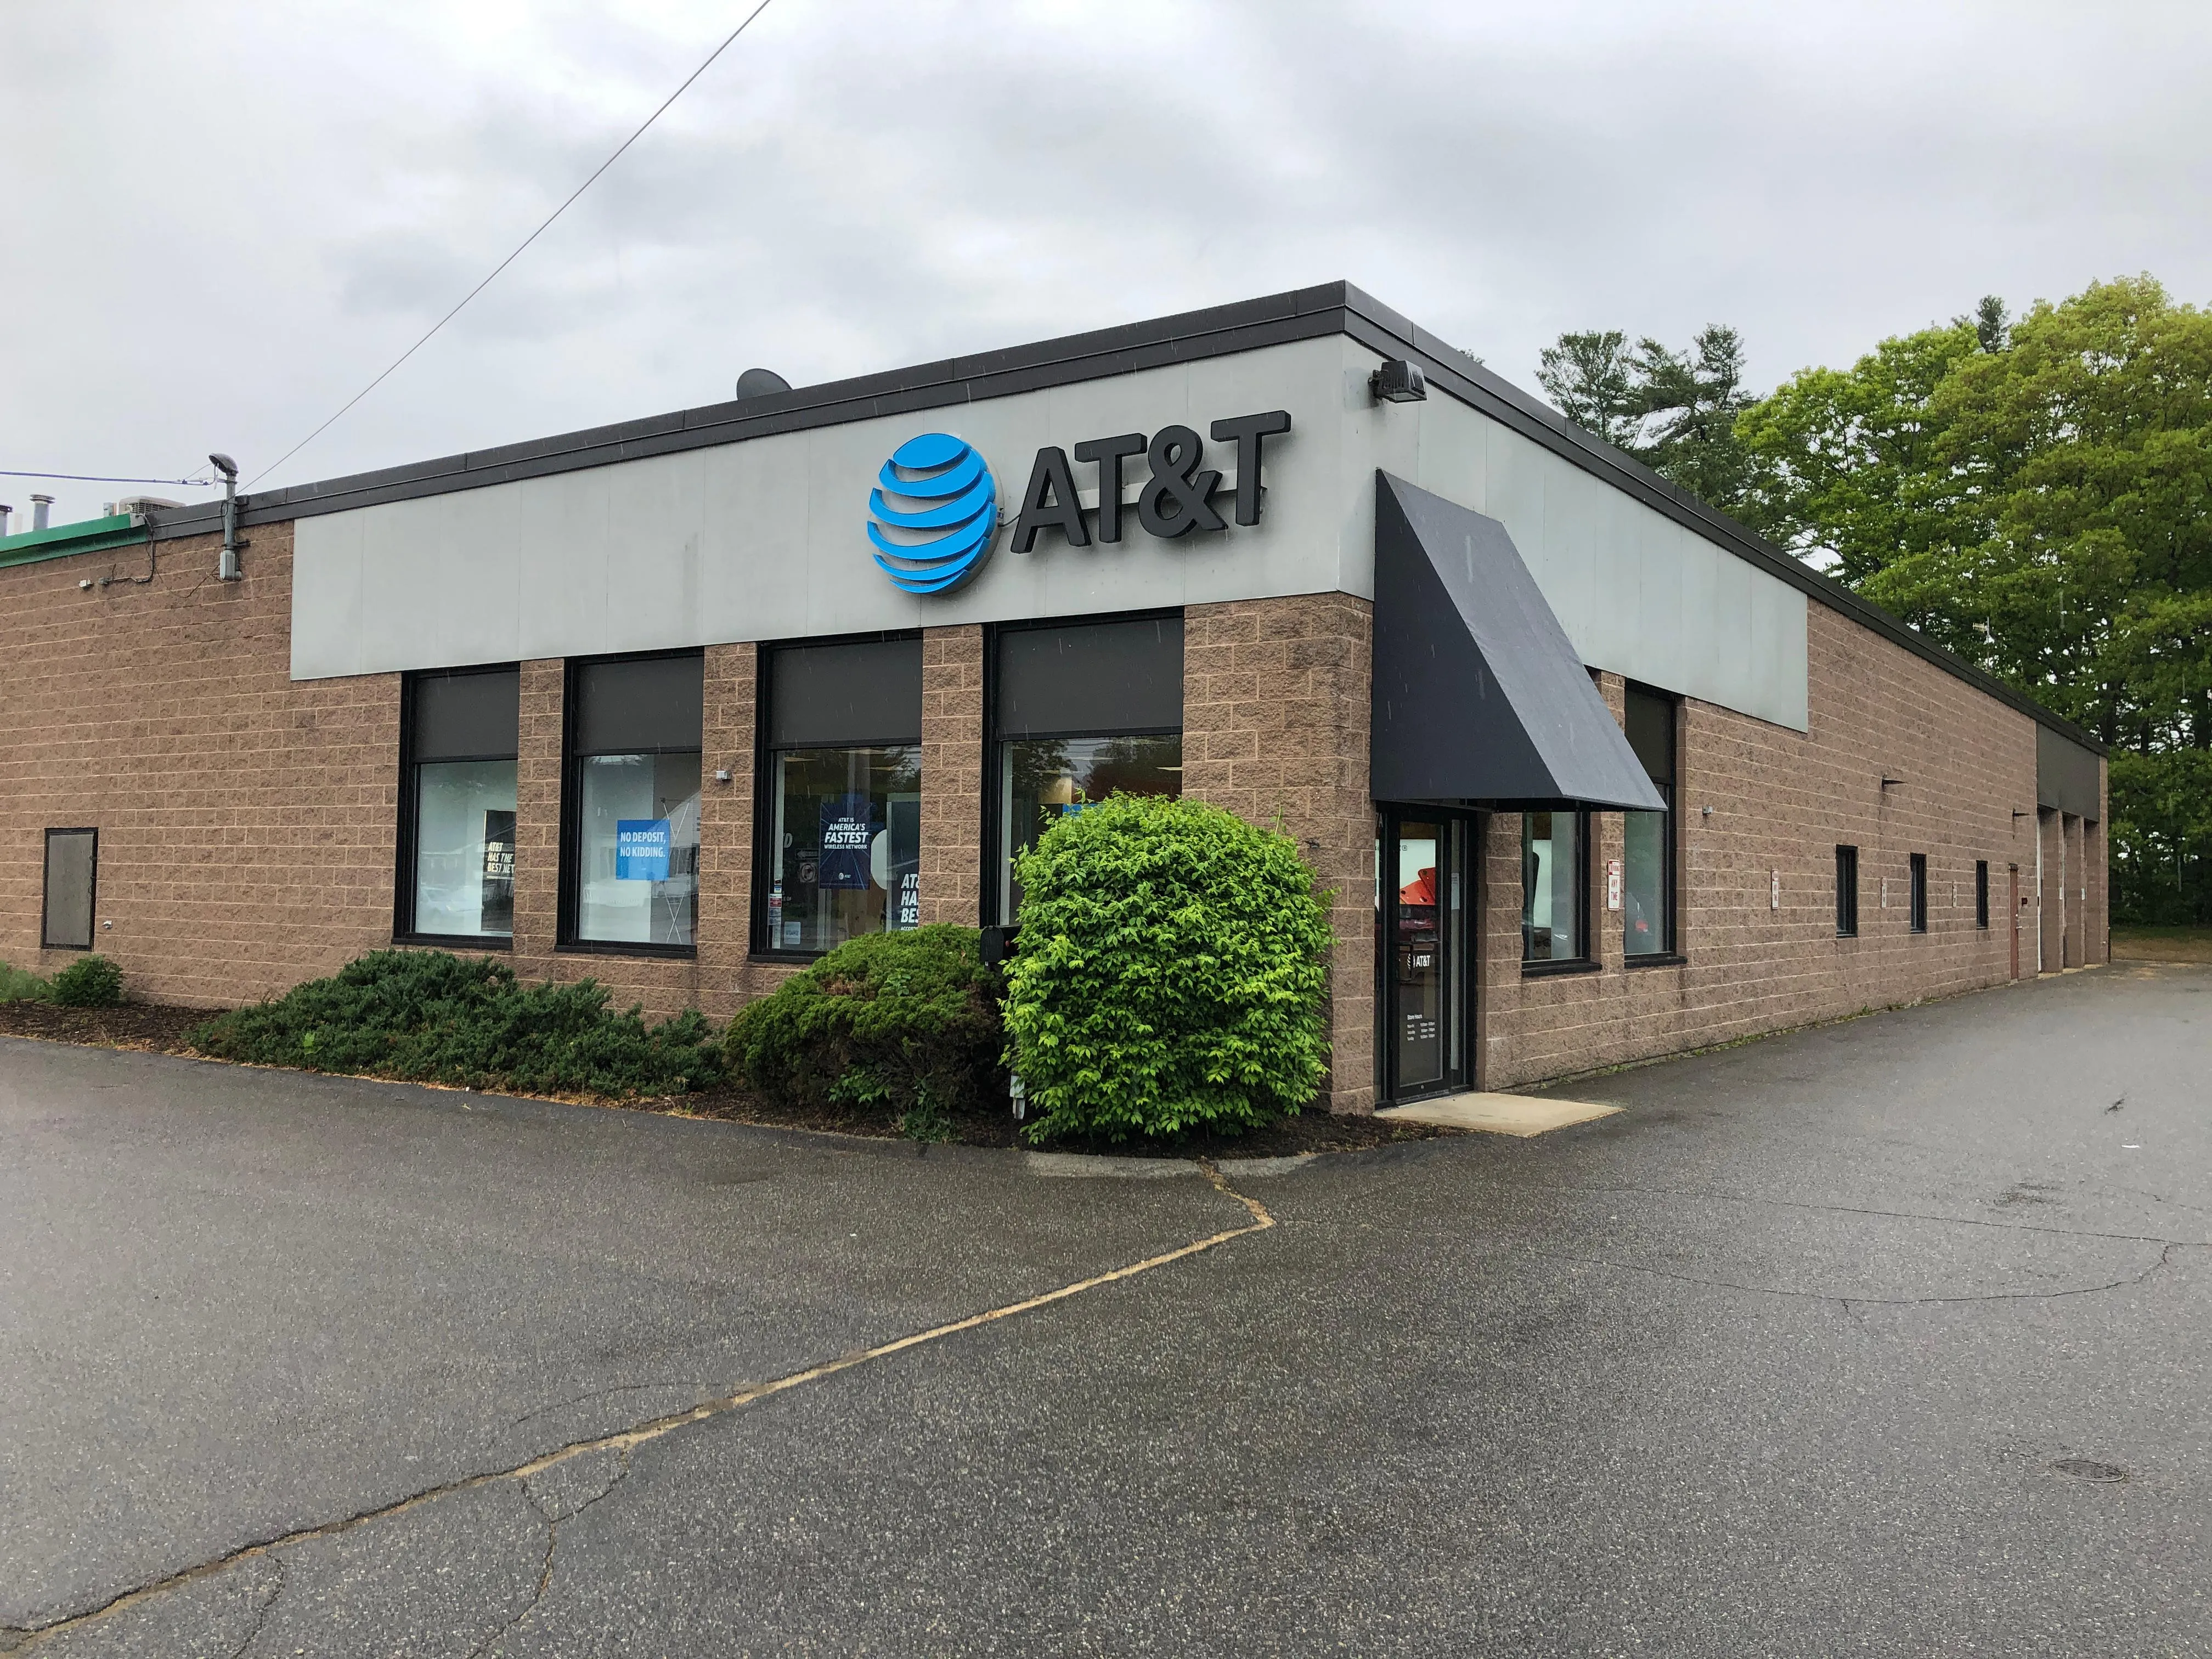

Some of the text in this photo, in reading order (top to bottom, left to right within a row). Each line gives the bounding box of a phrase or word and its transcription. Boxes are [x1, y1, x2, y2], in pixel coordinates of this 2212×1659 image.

[1011, 410, 1291, 554] AT&T
[620, 832, 666, 844] NO DEPOSIT,
[825, 832, 868, 843] FASTEST
[488, 842, 503, 851] AT&T
[620, 847, 665, 857] NO KIDDING.
[487, 852, 514, 863] HAS THE
[487, 862, 503, 873] BEST
[901, 890, 919, 906] HA
[1416, 955, 1430, 967] AT&T
